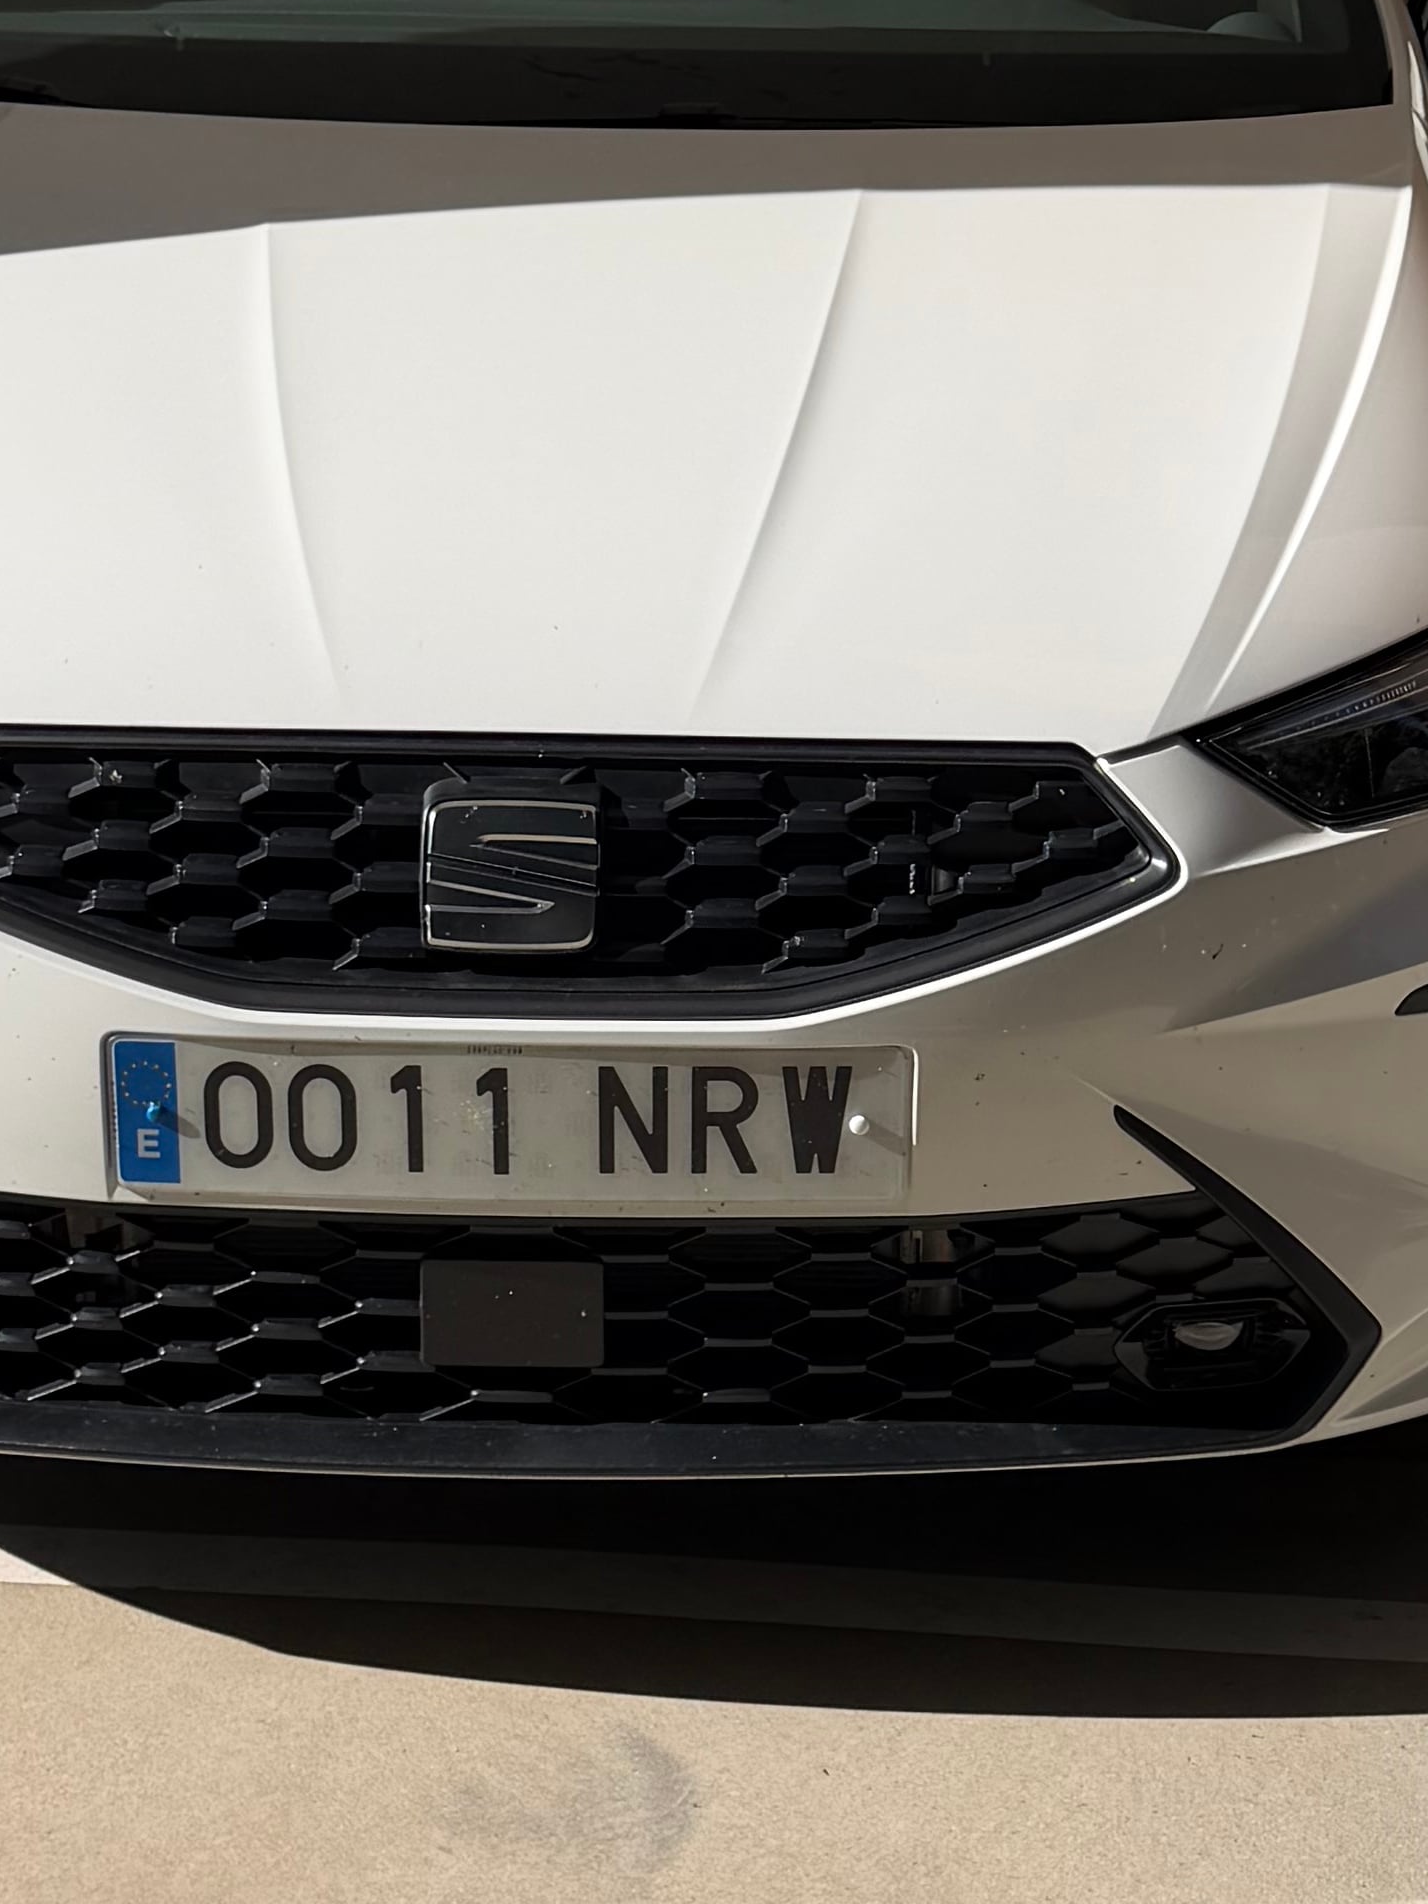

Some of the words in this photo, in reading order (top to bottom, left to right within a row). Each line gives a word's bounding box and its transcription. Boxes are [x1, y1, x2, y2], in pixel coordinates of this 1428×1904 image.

[136, 1128, 161, 1159] E
[203, 1062, 510, 1175] 0011
[598, 1065, 853, 1175] NRW
